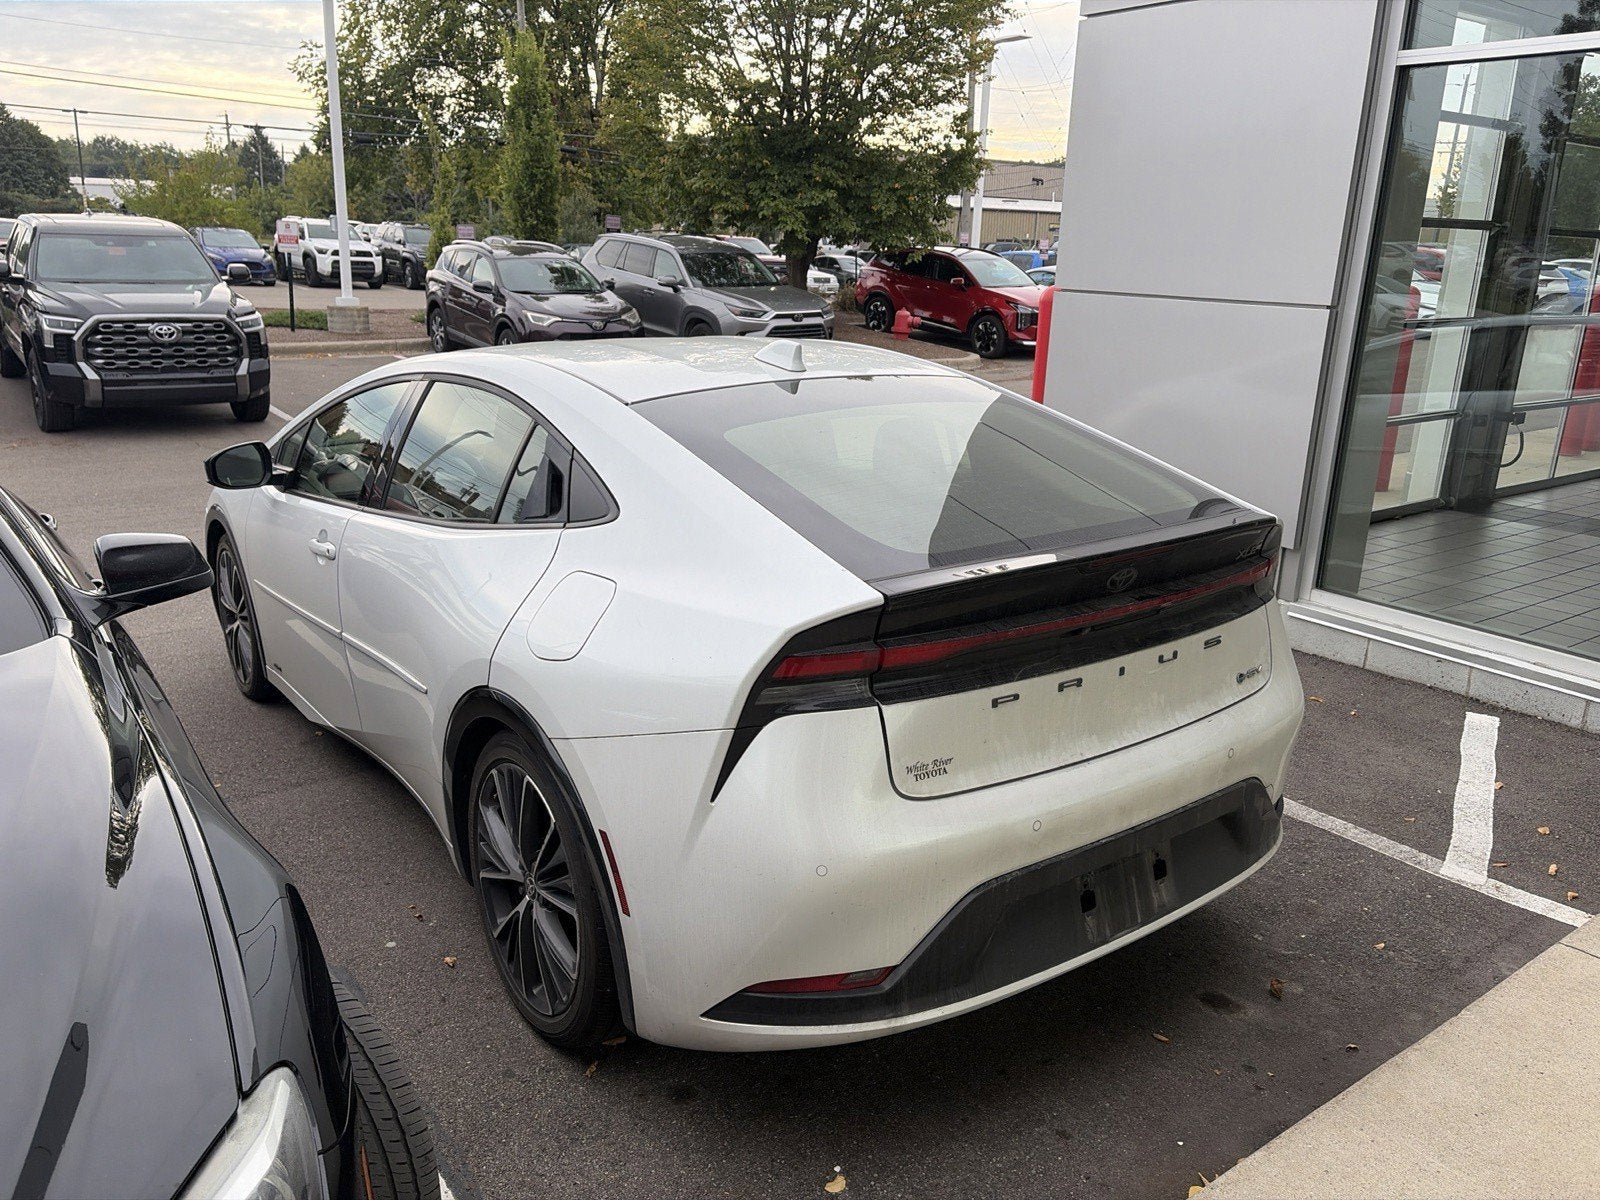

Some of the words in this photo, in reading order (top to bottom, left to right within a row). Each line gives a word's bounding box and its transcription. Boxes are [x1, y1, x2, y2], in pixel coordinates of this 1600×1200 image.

[991, 635, 1222, 709] PRIUS
[905, 761, 930, 775] White
[931, 757, 954, 769] River
[913, 767, 948, 782] TOYOTA
